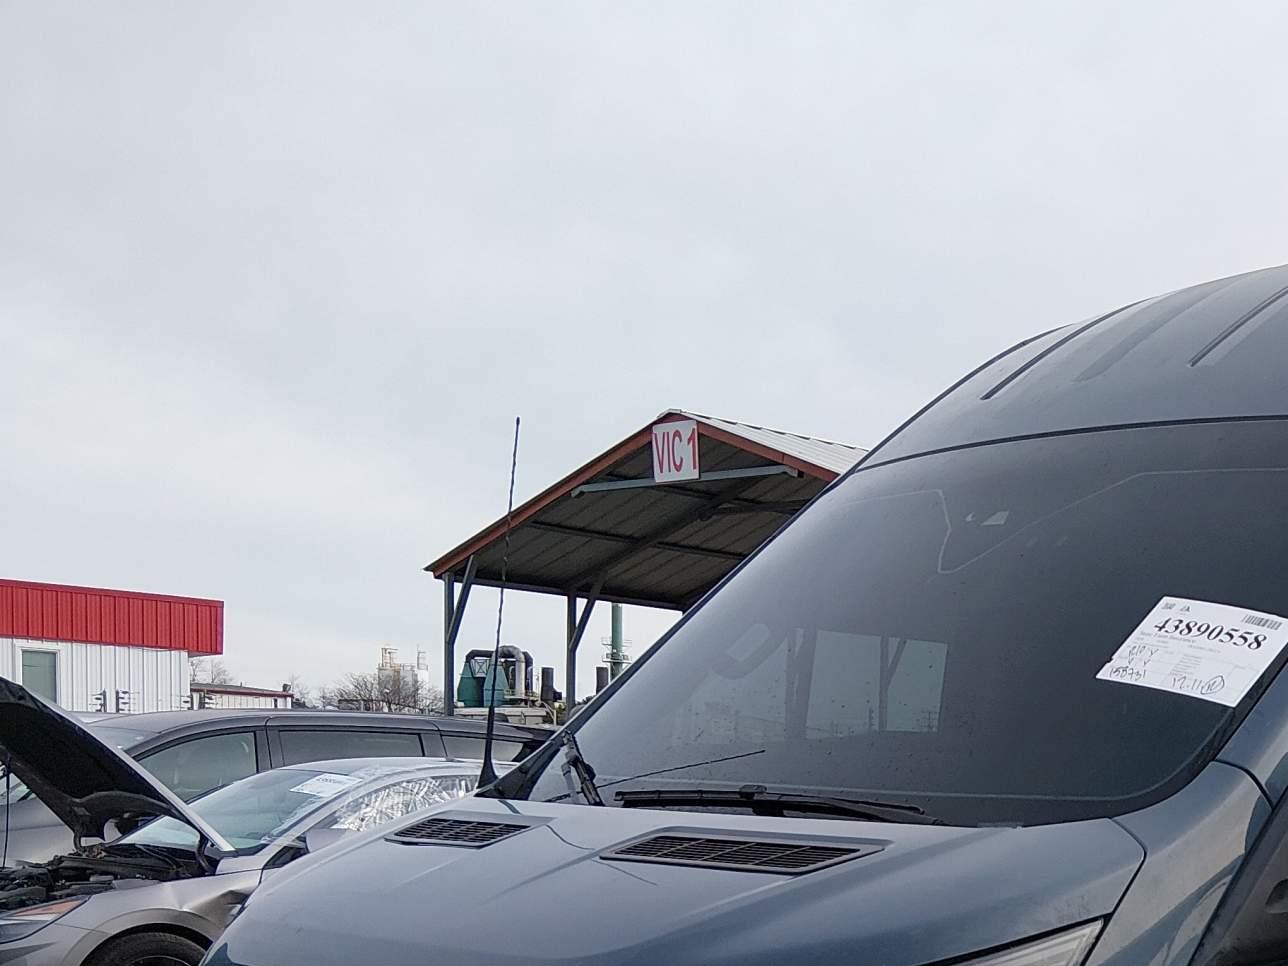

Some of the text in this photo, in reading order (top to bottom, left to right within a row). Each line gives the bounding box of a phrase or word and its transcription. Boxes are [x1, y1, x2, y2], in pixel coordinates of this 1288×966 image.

[654, 428, 697, 474] VIC 1
[1153, 617, 1268, 651] 43890558
